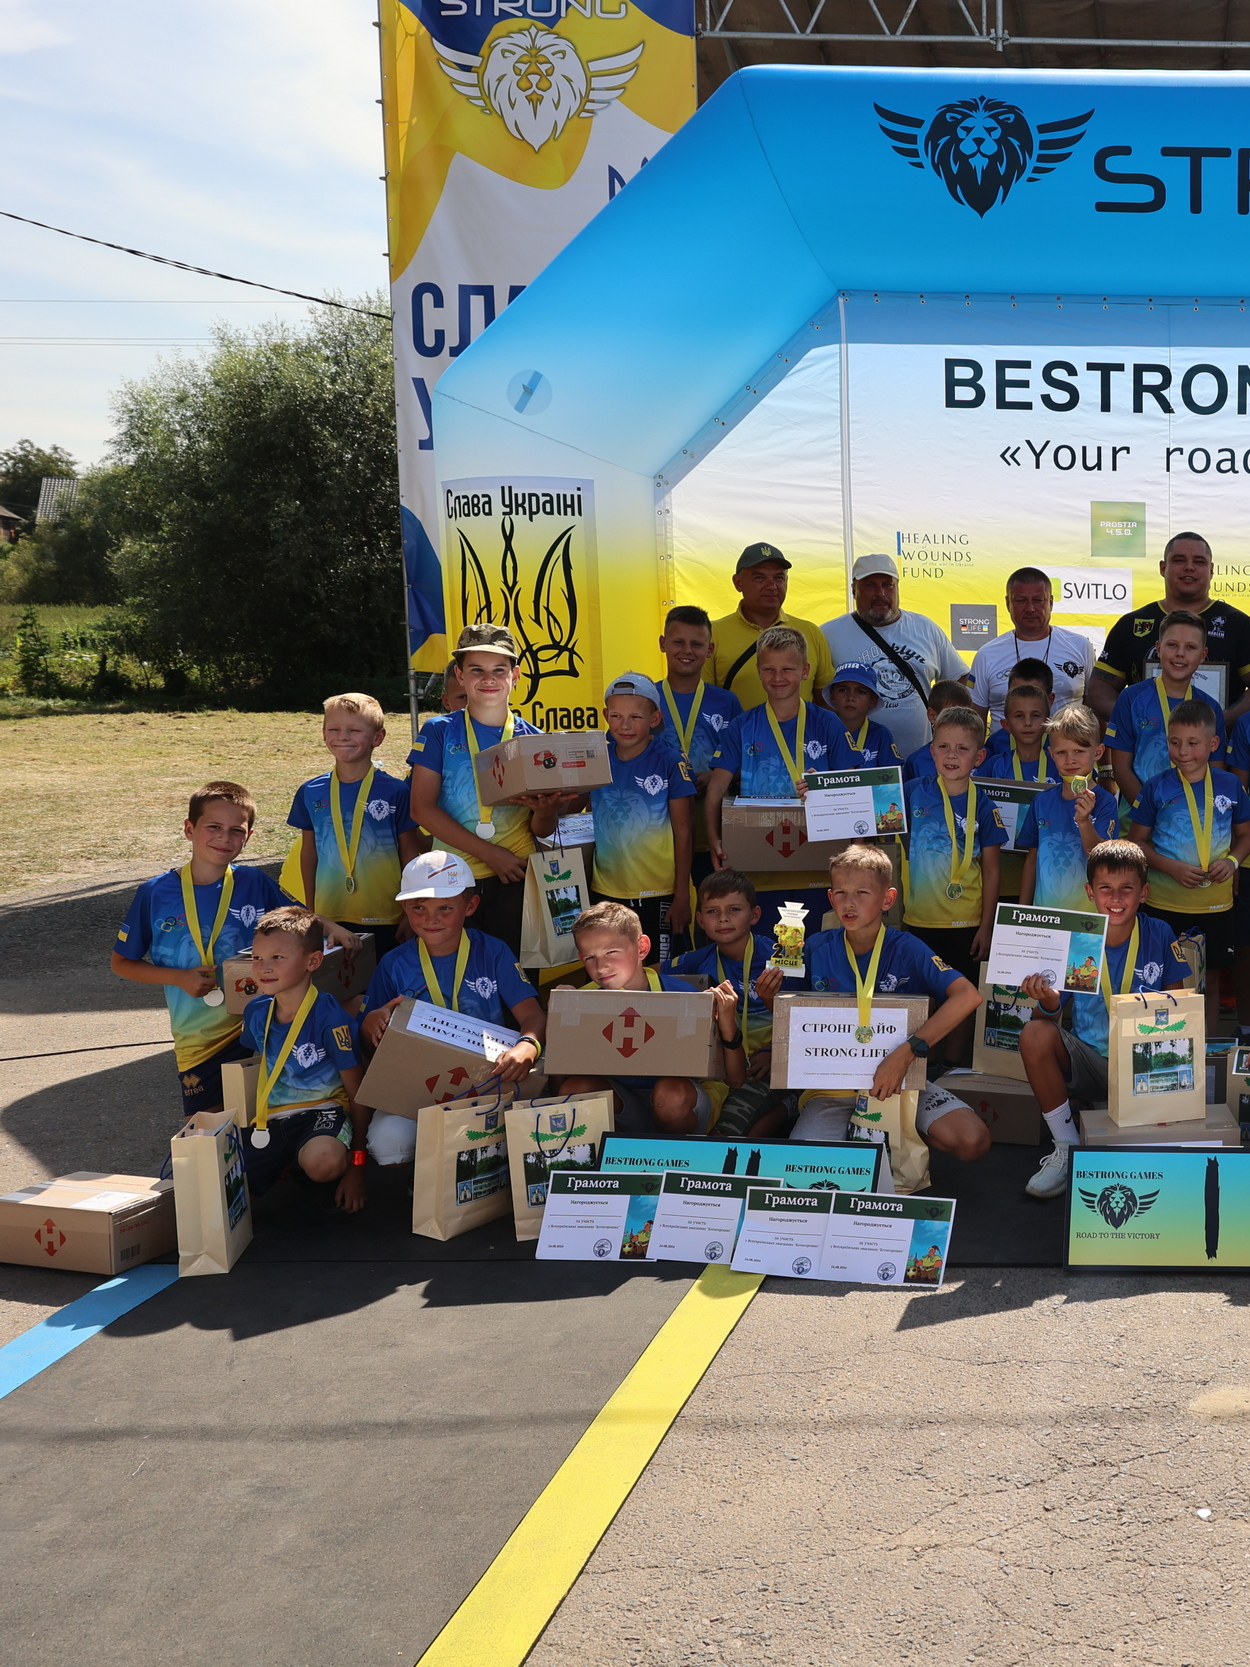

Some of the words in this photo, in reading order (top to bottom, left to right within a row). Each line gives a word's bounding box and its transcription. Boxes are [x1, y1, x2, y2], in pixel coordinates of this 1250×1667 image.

[446, 489, 492, 521] Слава
[901, 533, 969, 545] HEALING
[902, 550, 972, 562] WOUNDS
[902, 567, 944, 579] FUND
[1064, 582, 1127, 600] SVITLO
[532, 701, 599, 733] Слава
[817, 775, 861, 786] Грамота
[1012, 910, 1061, 925] Грамота
[775, 959, 798, 967] МІСЦЕ
[802, 1023, 856, 1034] СТРОНГ
[805, 1048, 858, 1058] STRONG
[862, 1049, 890, 1058] LIFE
[605, 1157, 656, 1167] BESTRONG
[657, 1159, 690, 1168] GAMES
[785, 1164, 837, 1174] BESTRONG
[838, 1166, 871, 1176] GAMES
[1076, 1171, 1129, 1180] BESTRONG
[1130, 1172, 1164, 1180] GAMES
[567, 1177, 620, 1191] Грамота
[680, 1177, 732, 1192] Грамота
[765, 1194, 818, 1208] Грамота
[850, 1197, 904, 1212] Грамота
